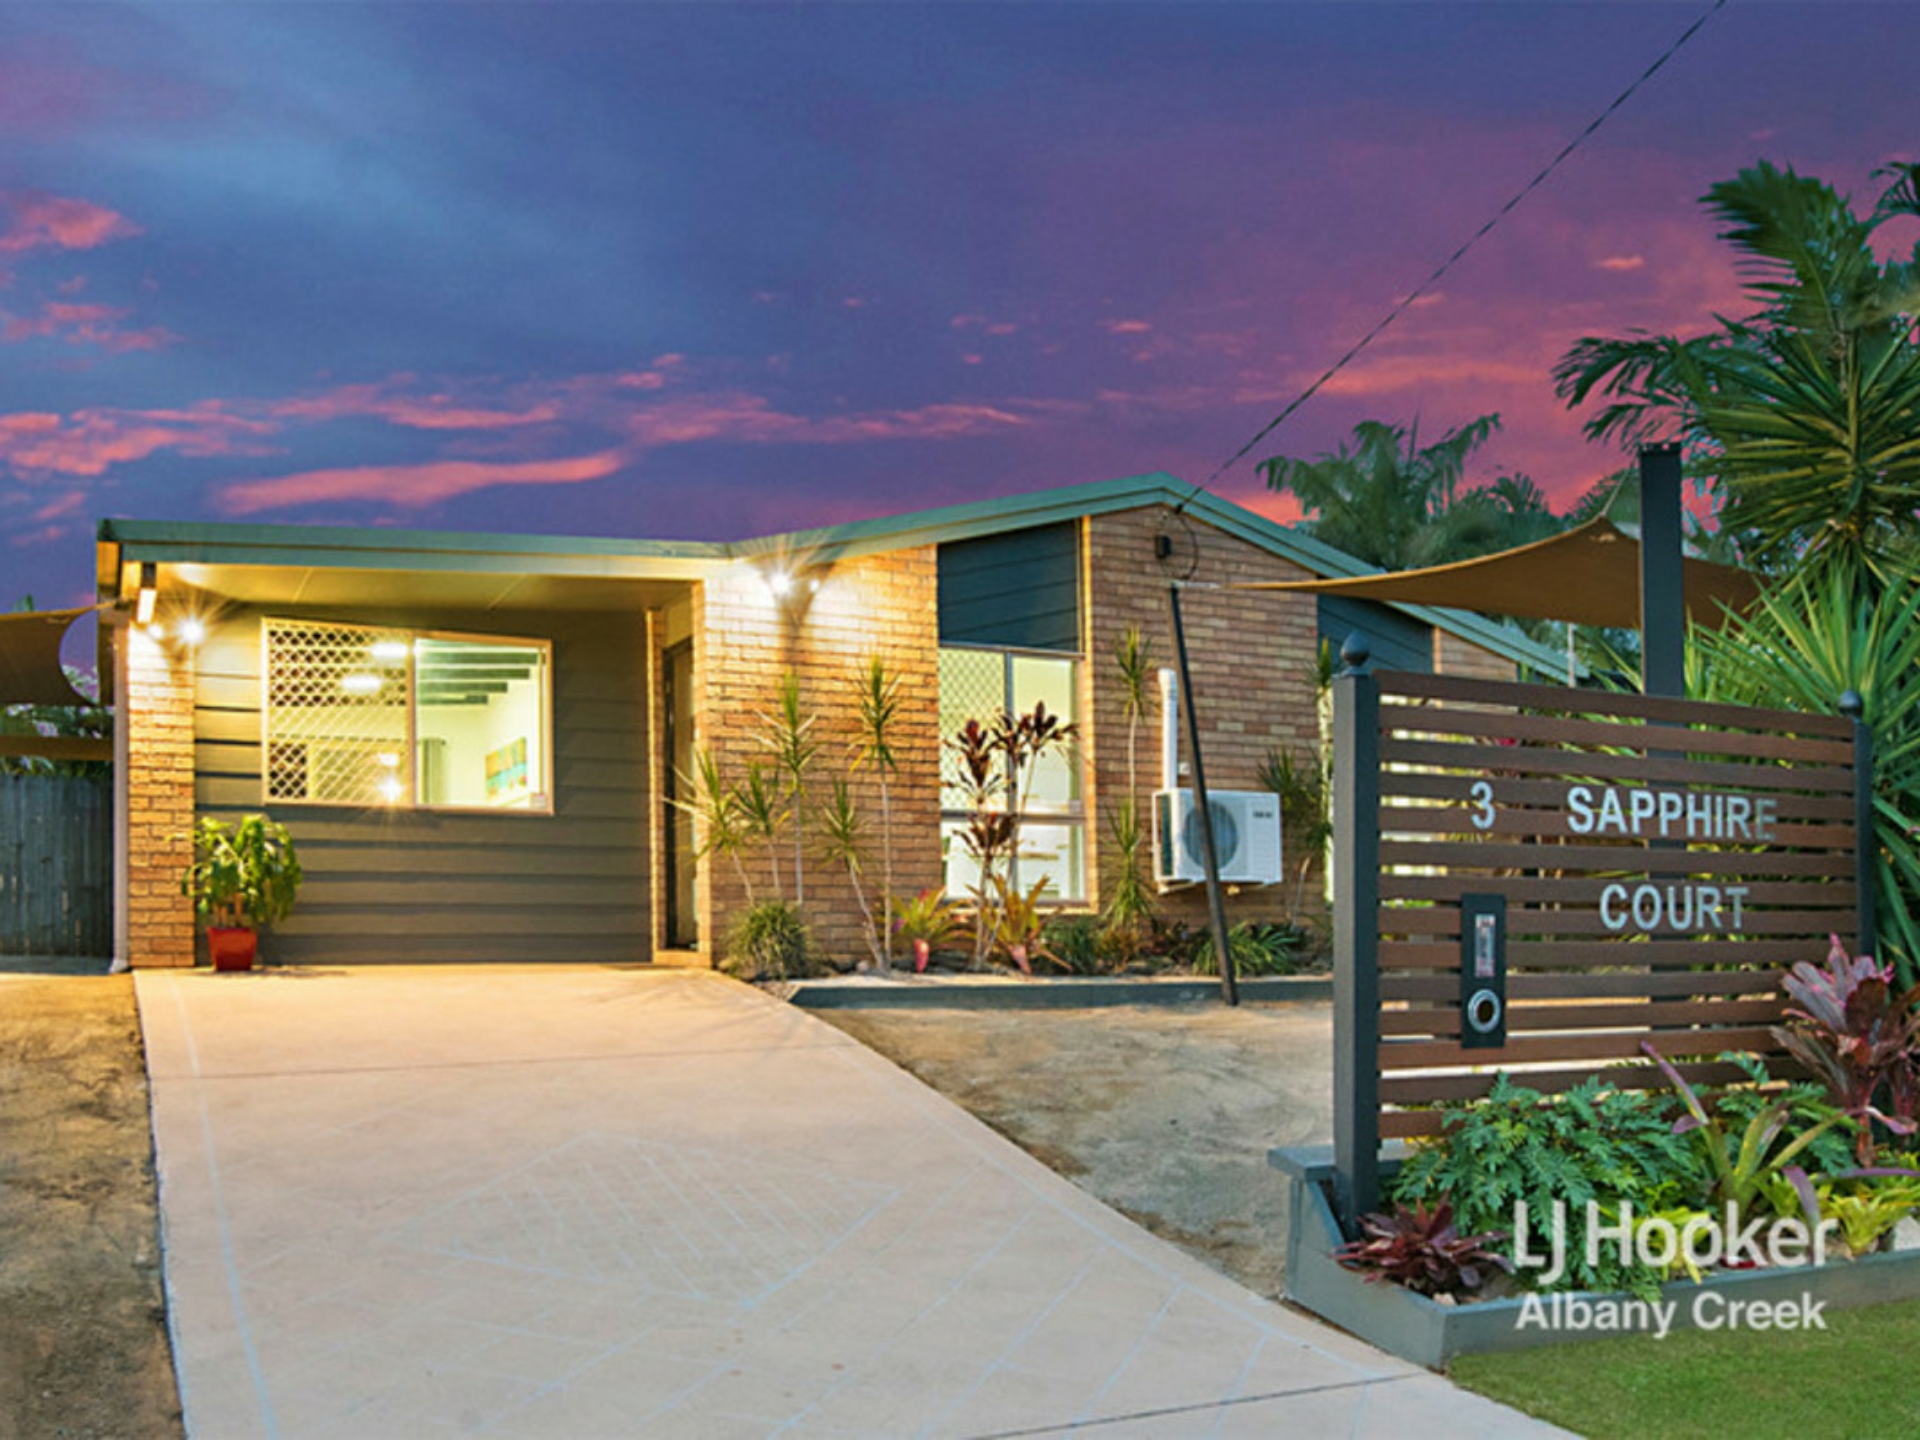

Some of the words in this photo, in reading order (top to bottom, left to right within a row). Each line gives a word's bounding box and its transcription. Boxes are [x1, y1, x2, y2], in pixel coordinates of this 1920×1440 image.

[1470, 781, 1496, 829] 3
[1567, 786, 1777, 841] SAPPHIRE
[1599, 883, 1749, 930] COURT
